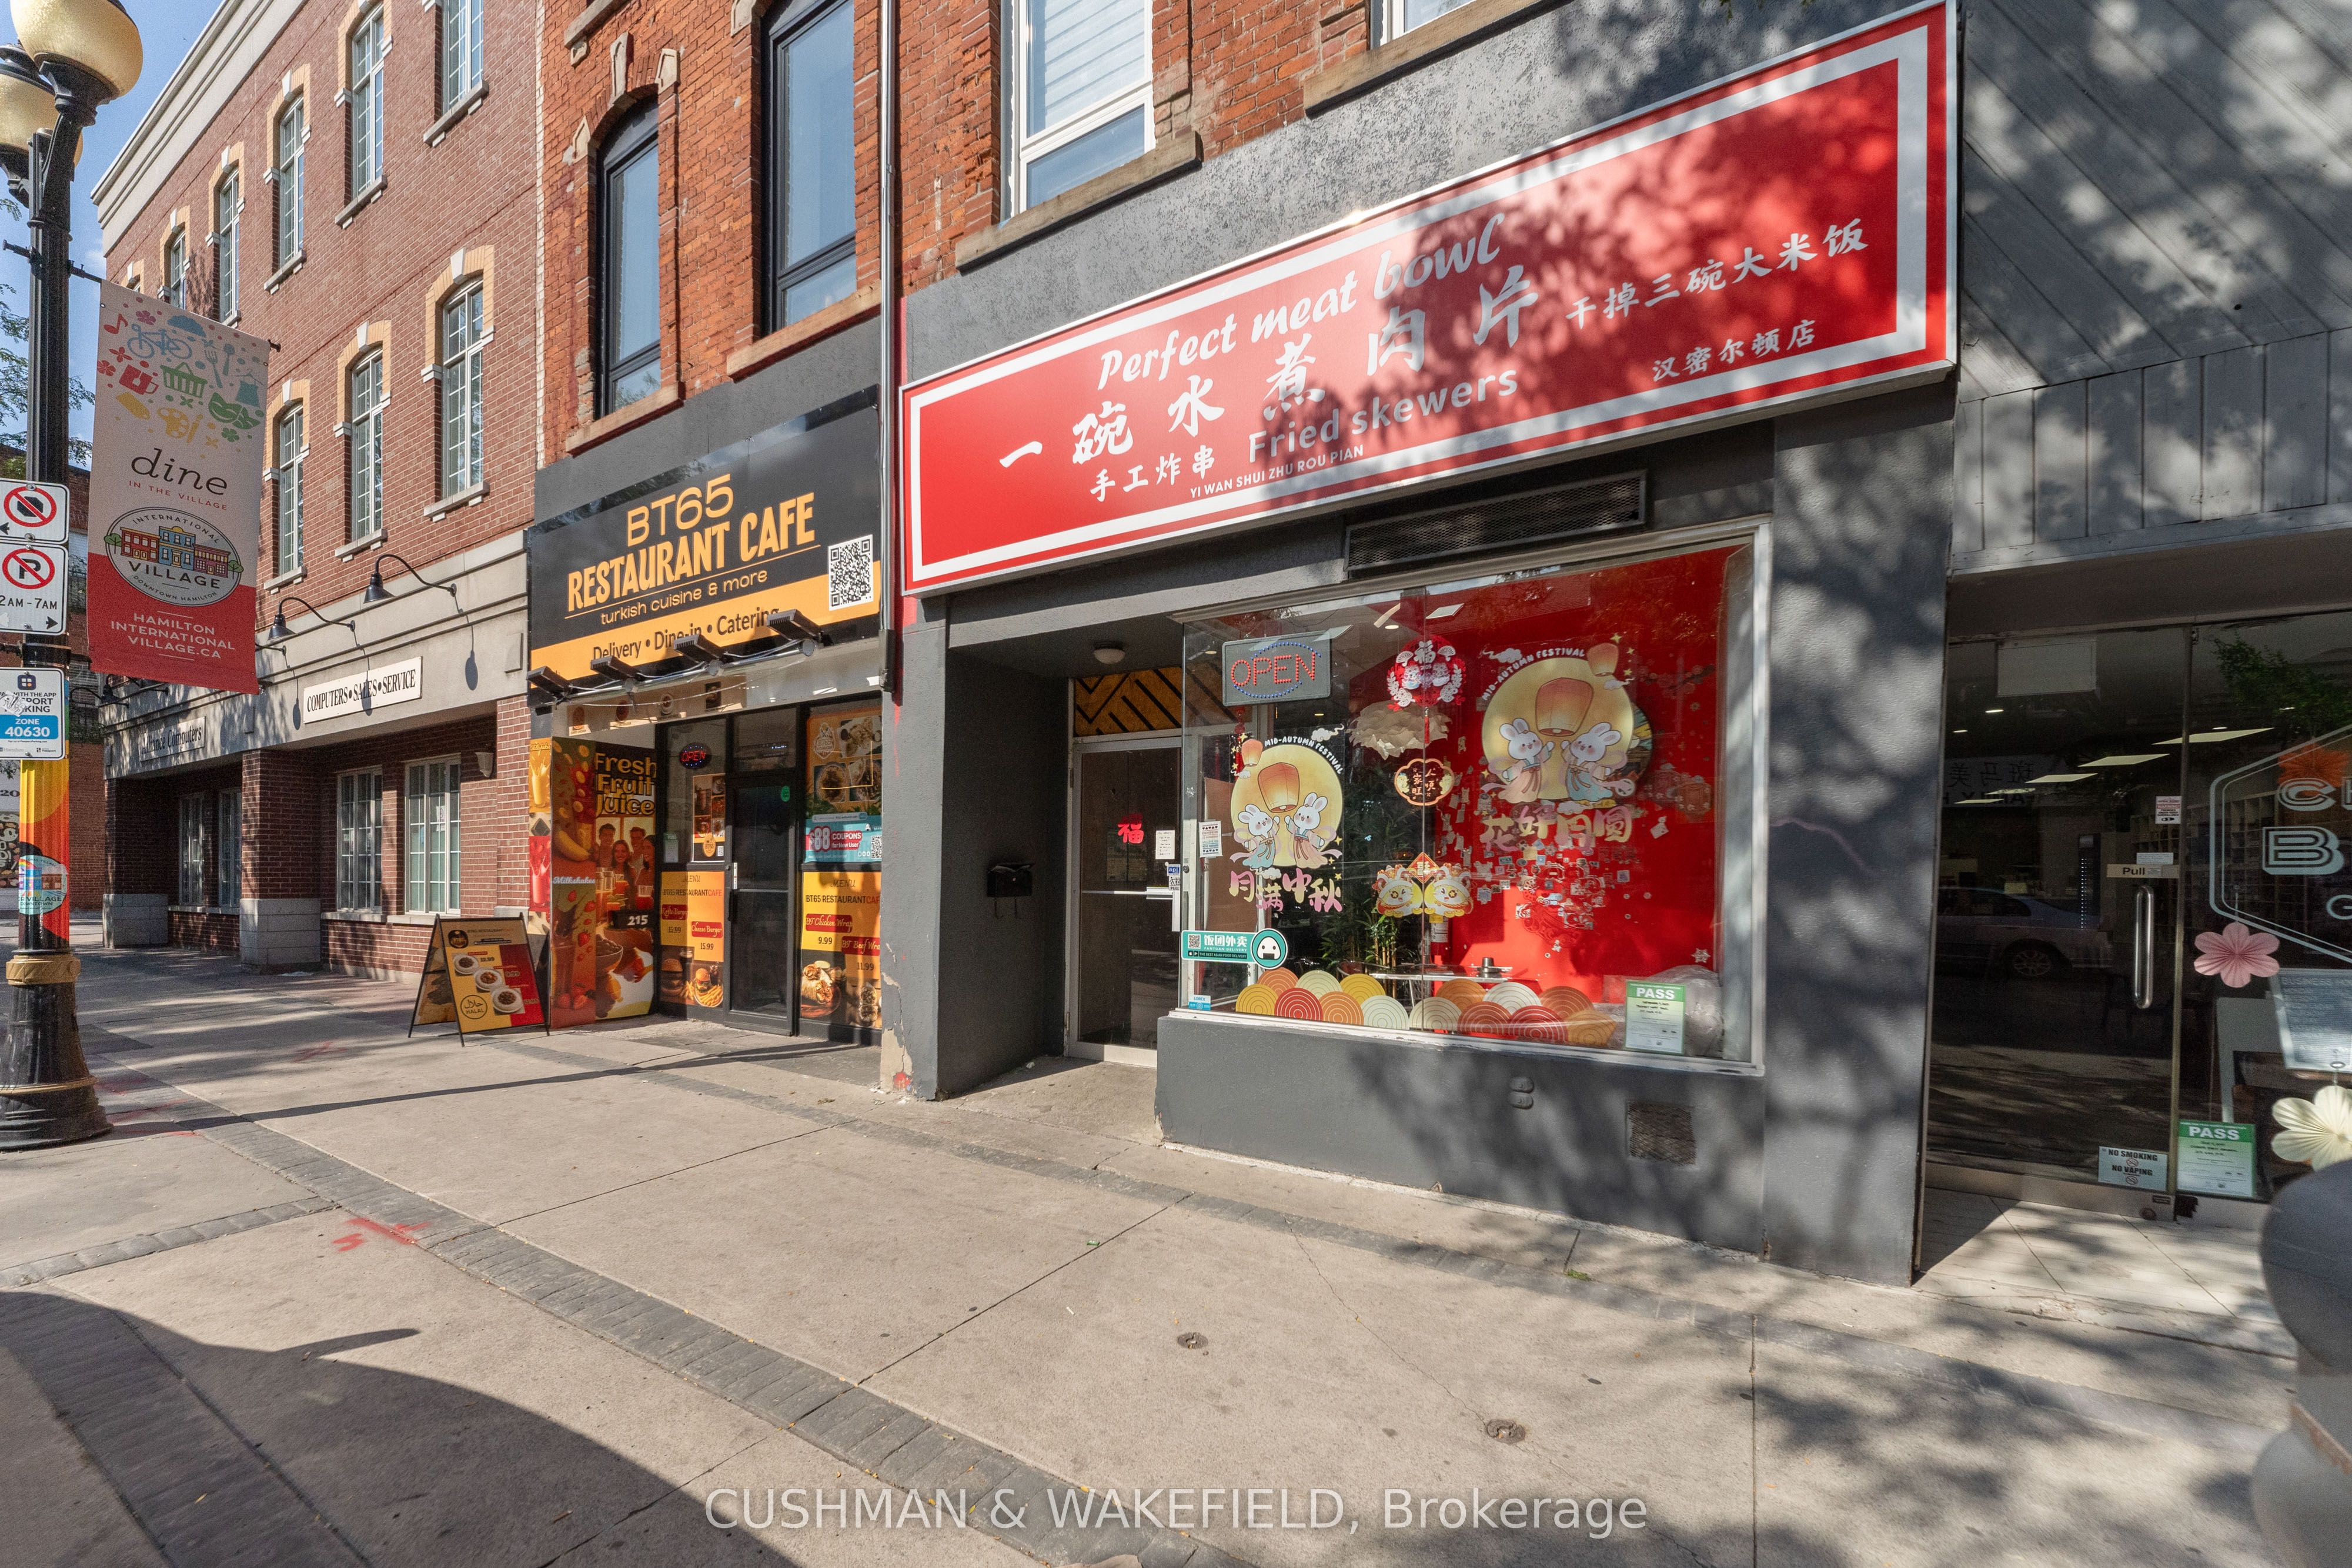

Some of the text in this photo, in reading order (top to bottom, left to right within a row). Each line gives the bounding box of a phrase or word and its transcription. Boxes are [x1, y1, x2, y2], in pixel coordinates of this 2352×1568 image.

[1566, 218, 1869, 329] 干掉三碗大米饭
[1097, 212, 1505, 390] Perfect meat bowl
[1652, 319, 1815, 382] 汉密尔顿店
[1000, 265, 1538, 468] 一碗水煮肉片
[1250, 369, 1518, 463] Fried skewers
[131, 447, 228, 496] dine
[1090, 444, 1214, 502] 手工炸串
[1190, 444, 1363, 499] YI WAN SHUI ZHU ROU PIAN
[129, 480, 228, 511] IN THE VILLAGE
[627, 473, 734, 547] BT65
[133, 513, 219, 544] INTERNATIONAL
[567, 492, 816, 613] RESTAURANT CAFE
[128, 560, 220, 589] VILLAGE
[133, 574, 218, 602] DOWNTOWN HAMILTON
[601, 569, 768, 625] turkish cuisine & more
[111, 621, 235, 651] INTERNATIONAL
[133, 613, 215, 635] HAMILTON
[128, 635, 222, 658] VILLAGE.CA
[593, 640, 642, 660] Delivery
[1231, 652, 1315, 687] OPEN
[1482, 647, 1586, 700] MID-AUTUMN FESTIVAL
[5, 727, 51, 737] 40630
[141, 726, 202, 754] Alliance Computers
[595, 753, 657, 779] Fresh
[681, 750, 706, 763] OPEN
[1264, 735, 1344, 774] MID-AUTUMN FESTIVAL
[597, 774, 654, 796] Fruit
[596, 794, 655, 818] Juice
[1118, 813, 1144, 844] 福
[553, 876, 596, 884] Milkshakes
[2123, 867, 2145, 875] Pull
[830, 879, 856, 888] MENU
[1229, 868, 1344, 912] 月满中秋
[806, 895, 821, 903] BT65
[627, 915, 649, 926] 215
[691, 922, 722, 937] Cheese Burger
[815, 914, 836, 927] Chicken
[836, 918, 853, 933] Wrap
[700, 942, 714, 951] 15.99
[818, 937, 833, 945] 9.99
[854, 940, 867, 954] Beef
[1204, 934, 1247, 947] 饭团外卖
[857, 962, 874, 971] 11.99
[465, 1000, 483, 1009] حلال
[1636, 988, 1675, 999] PASS
[2189, 1126, 2240, 1141] PASS
[2121, 1151, 2158, 1162] SMOKING
[2124, 1166, 2153, 1176] VAPING
